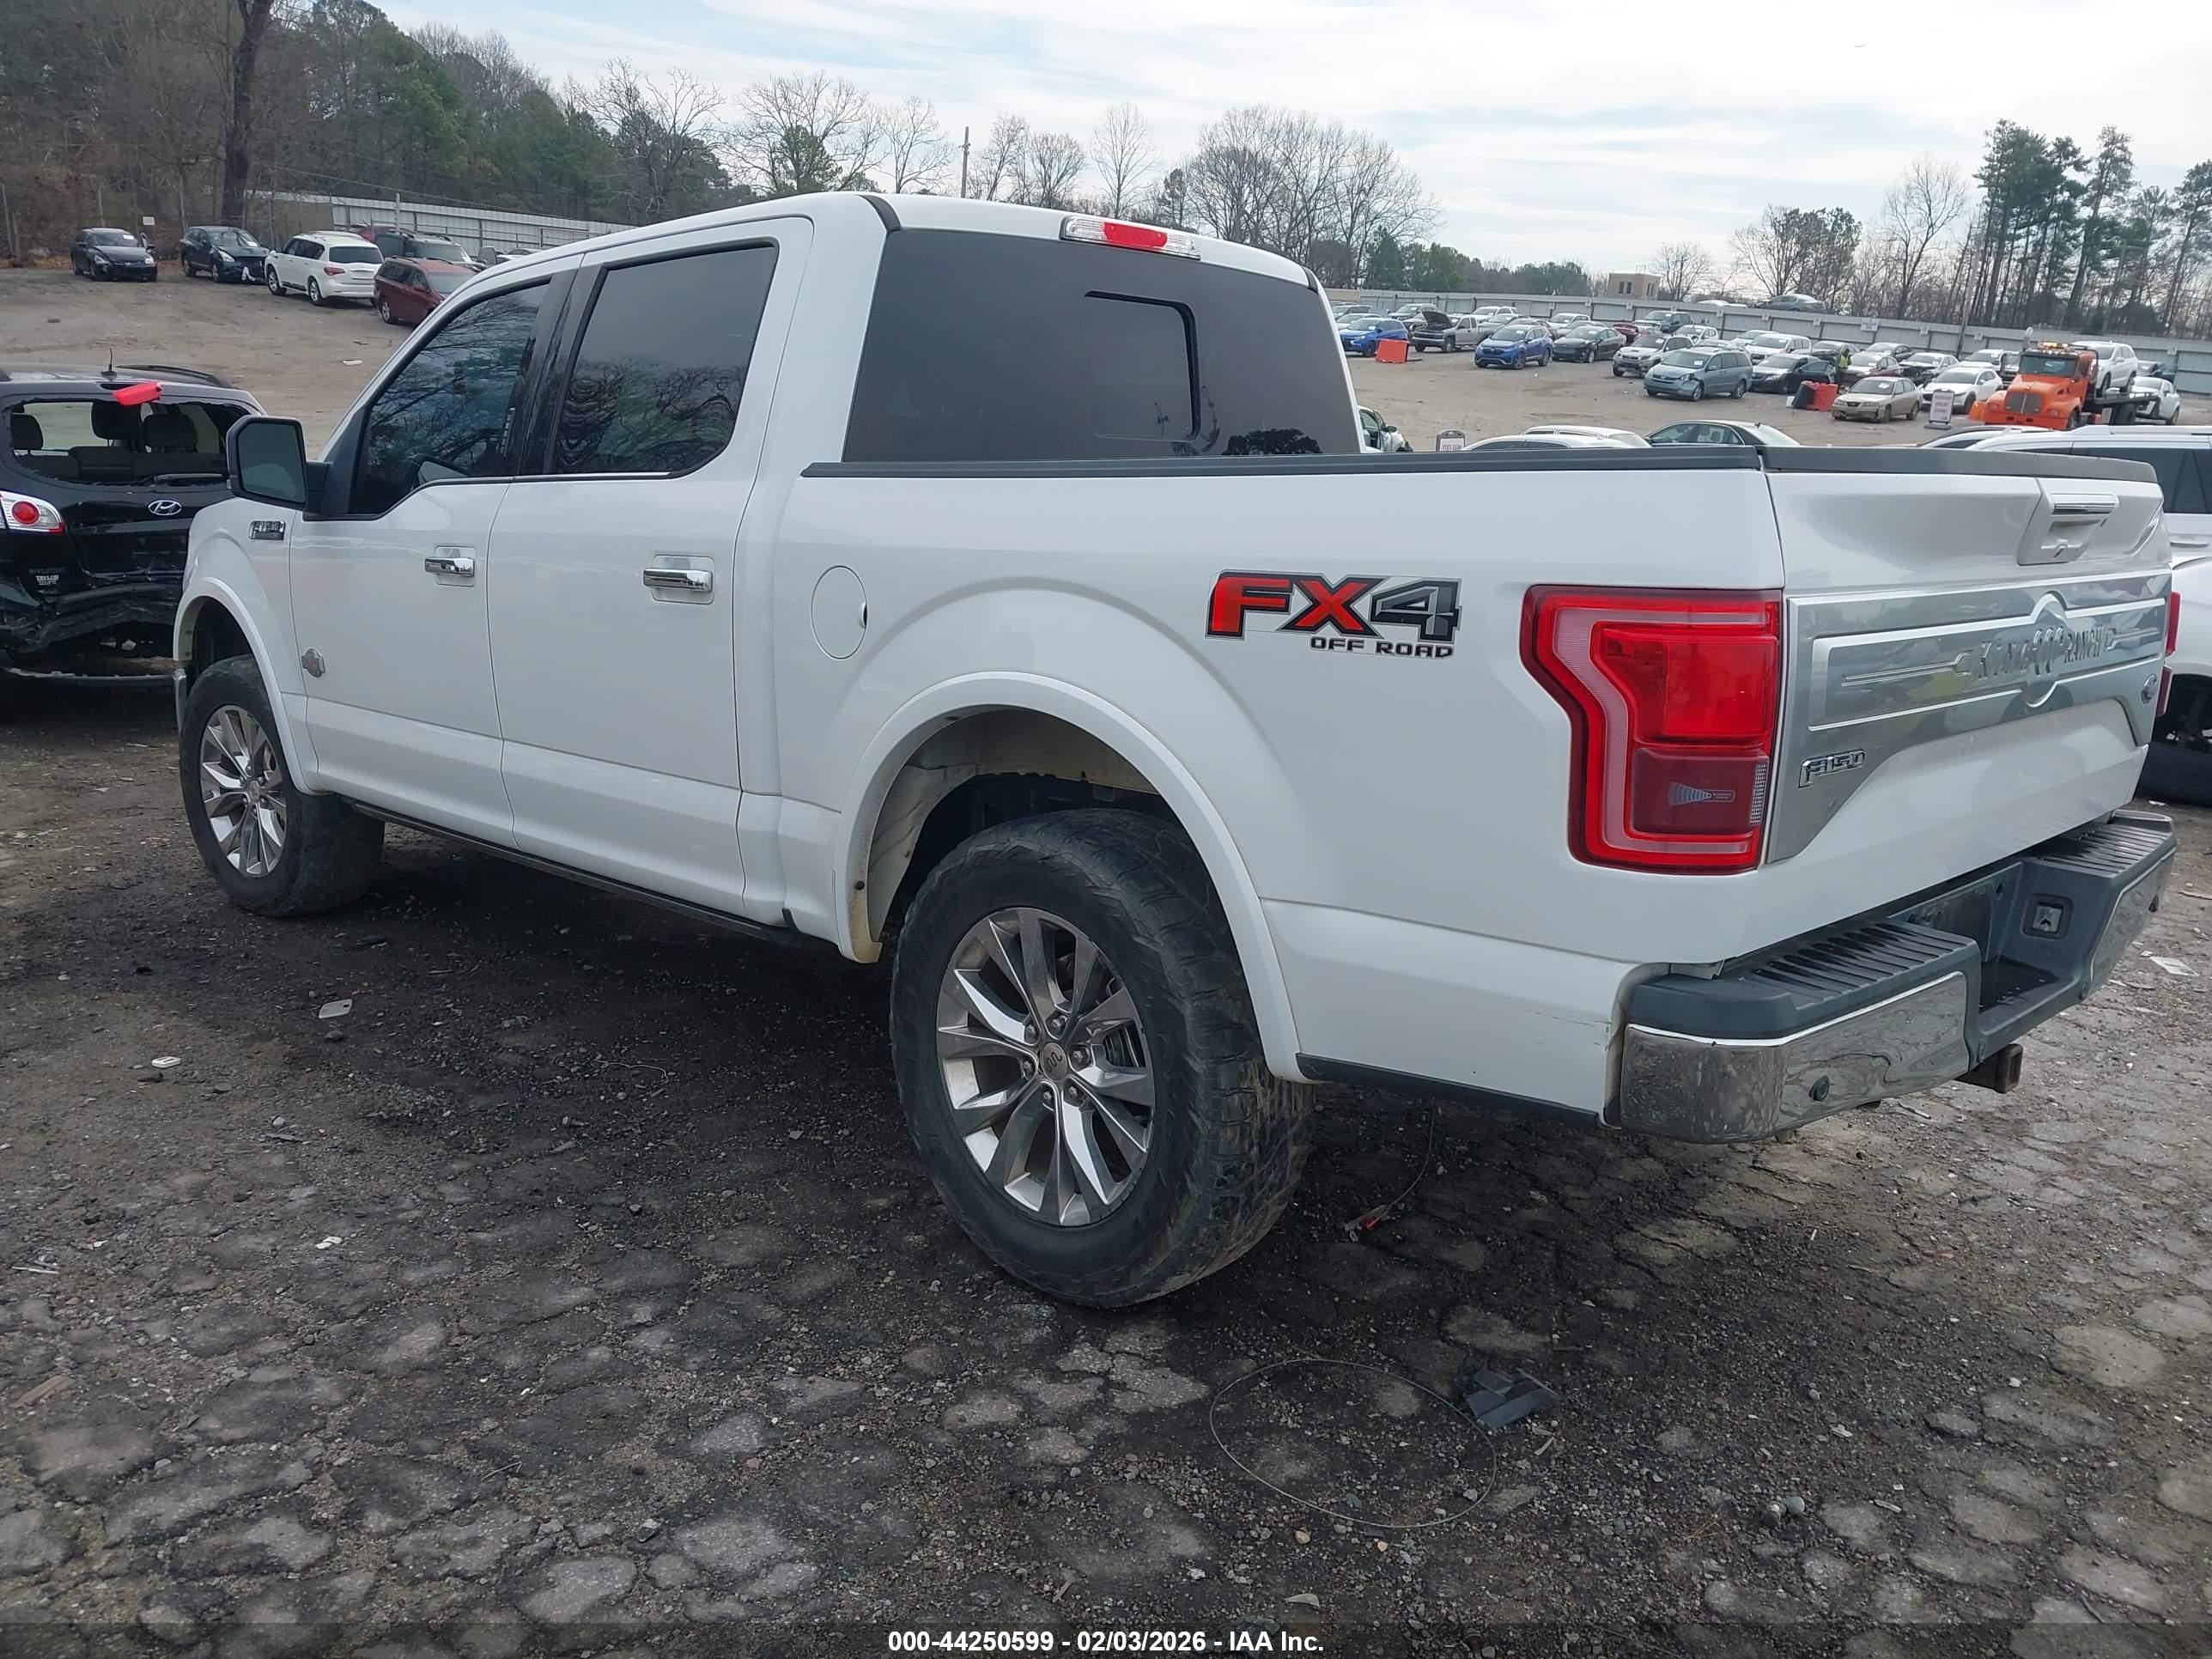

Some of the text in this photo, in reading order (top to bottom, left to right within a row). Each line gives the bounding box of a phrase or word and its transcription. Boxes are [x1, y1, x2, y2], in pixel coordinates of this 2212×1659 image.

[1206, 570, 1461, 642] FX4
[1310, 635, 1454, 659] OFF ROAD
